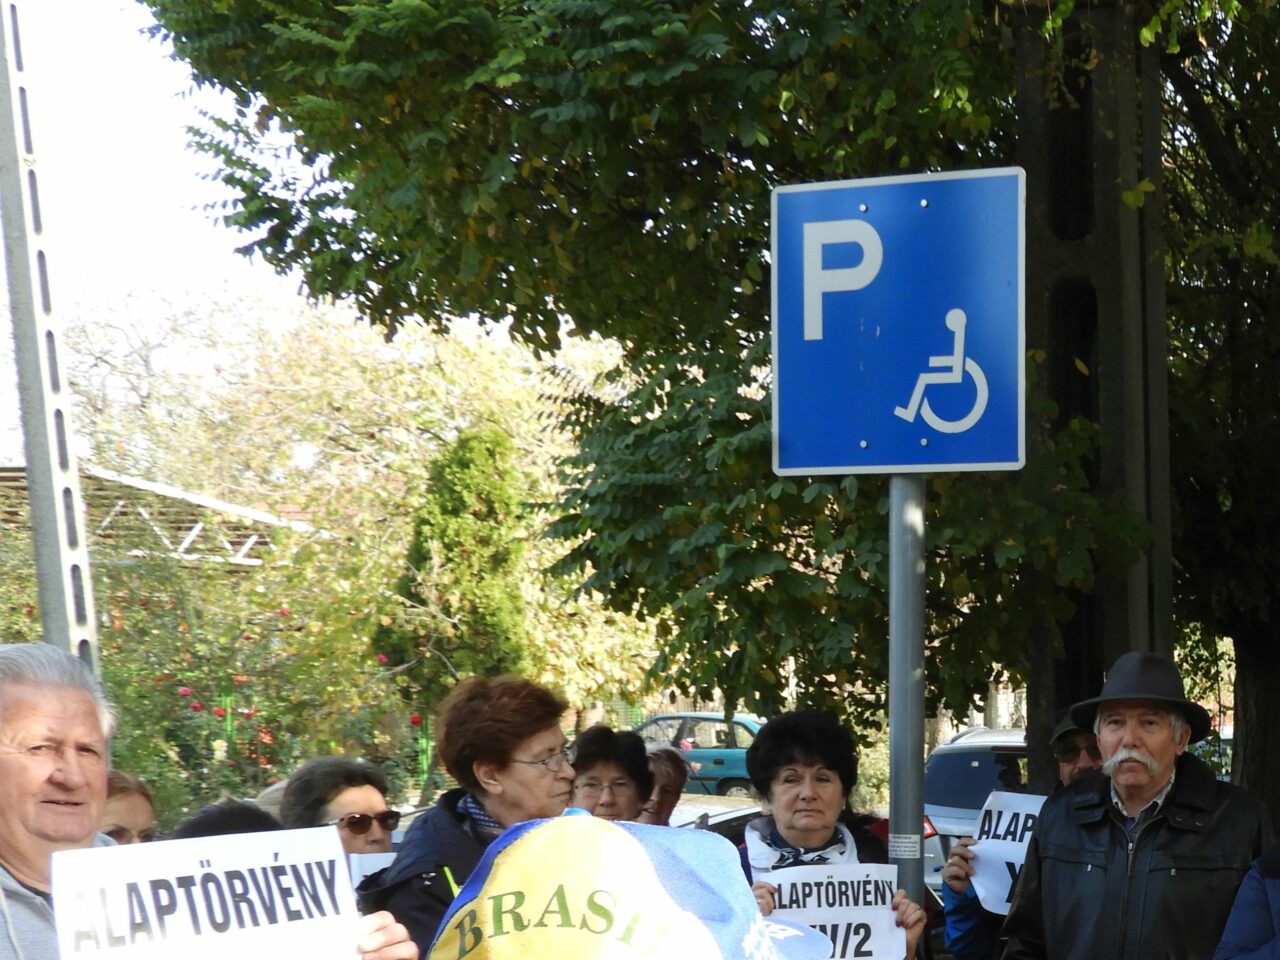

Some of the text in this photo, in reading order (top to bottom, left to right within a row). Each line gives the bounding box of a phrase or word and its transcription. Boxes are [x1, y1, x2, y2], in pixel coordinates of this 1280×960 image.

[803, 219, 884, 341] P
[74, 852, 341, 952] ALAPTÖRVÉNY
[772, 874, 895, 910] LAPTÖRVÉNY
